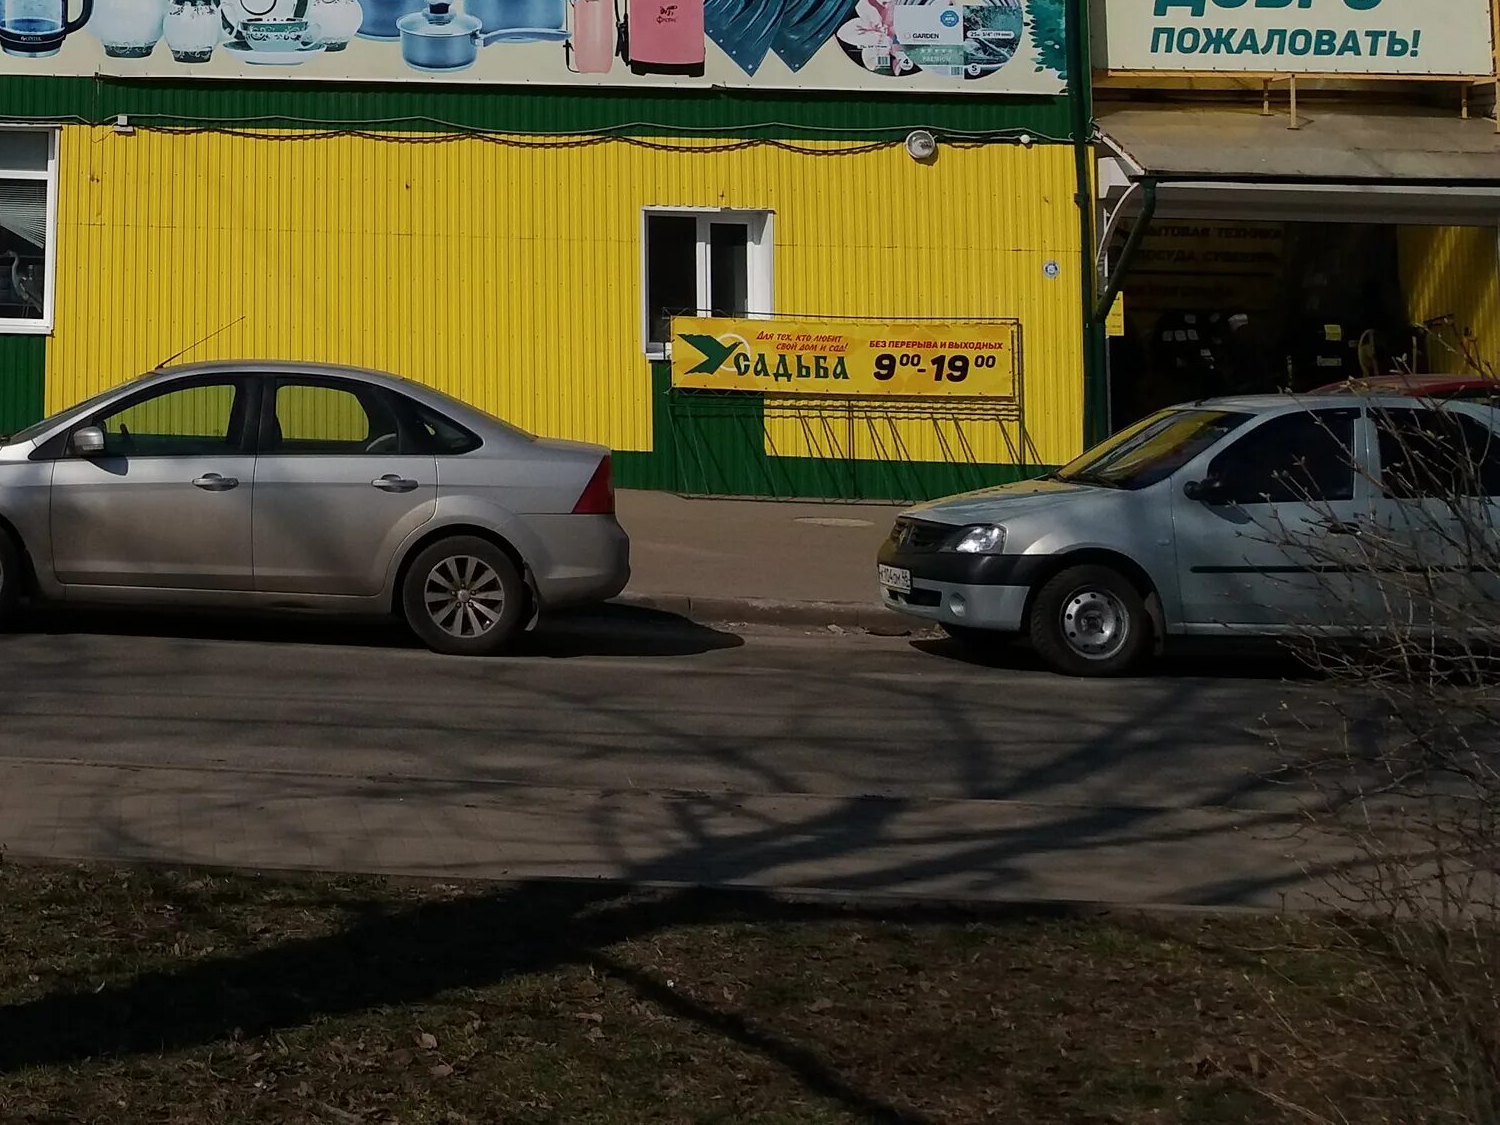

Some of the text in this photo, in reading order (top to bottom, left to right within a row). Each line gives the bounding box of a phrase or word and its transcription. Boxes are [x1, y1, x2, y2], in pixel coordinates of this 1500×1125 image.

[1150, 26, 1421, 58] ПОЖАЛОВАТЬ!
[756, 330, 774, 340] Для
[795, 334, 812, 342] кто
[814, 335, 843, 343] любит
[776, 341, 849, 353] свой дом и сад!
[869, 340, 1003, 351] БЕЗ ПЕРЕРЫВА И ВЫХОДНЫХ
